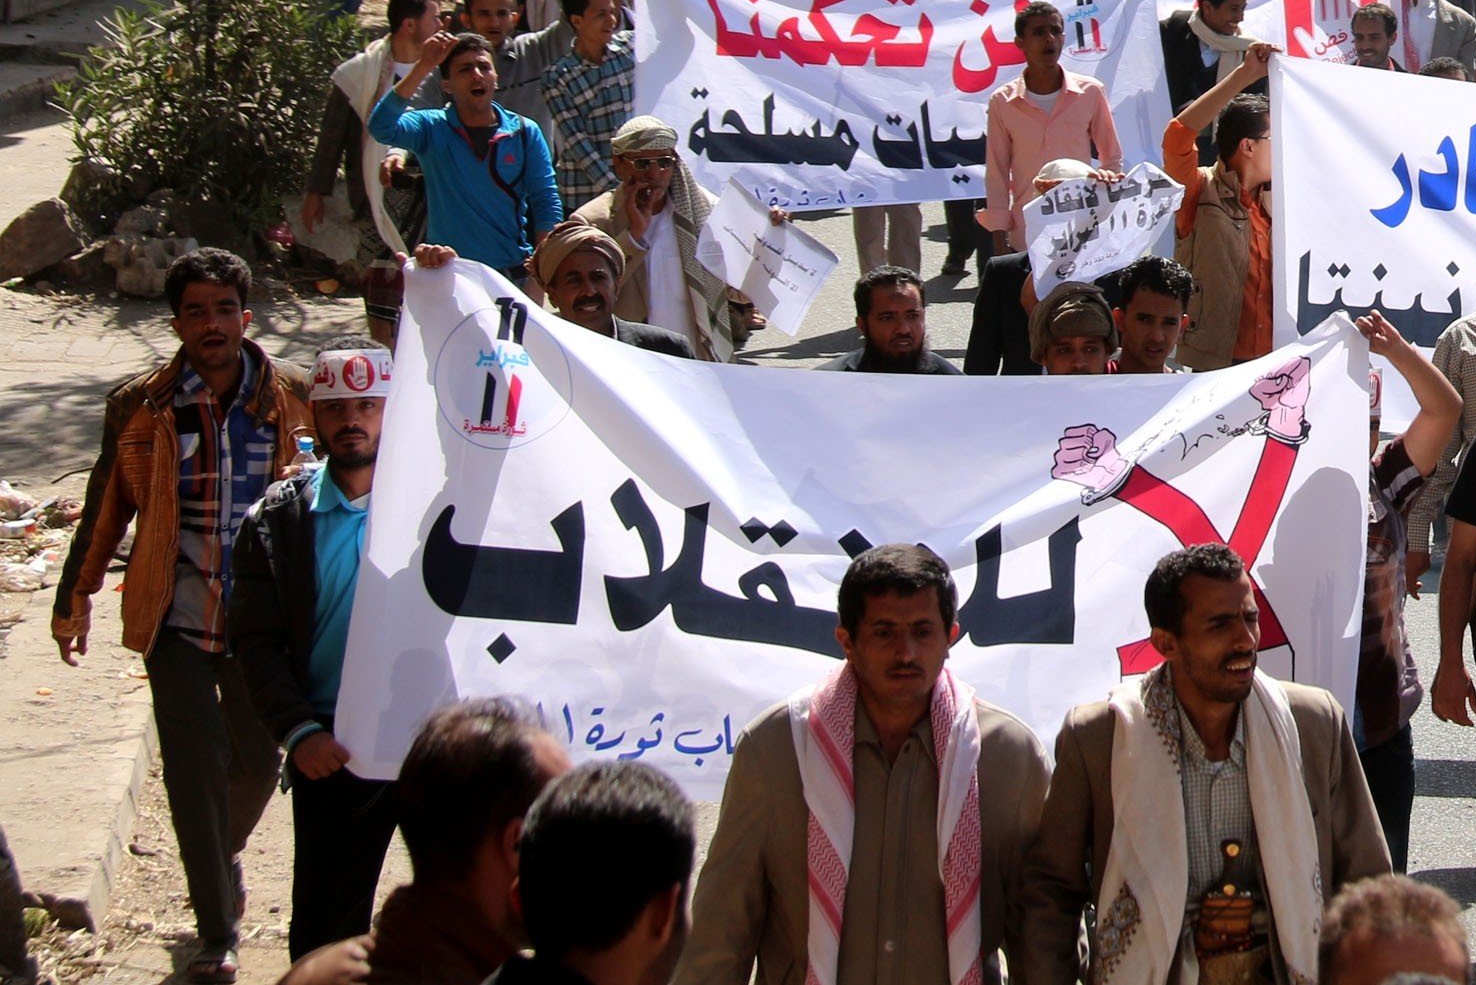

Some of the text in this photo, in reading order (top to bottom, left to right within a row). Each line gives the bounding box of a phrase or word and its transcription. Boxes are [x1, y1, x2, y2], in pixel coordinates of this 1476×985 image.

[688, 92, 860, 171] مسلحة
[494, 297, 528, 345] 11
[476, 346, 529, 368] فبراير
